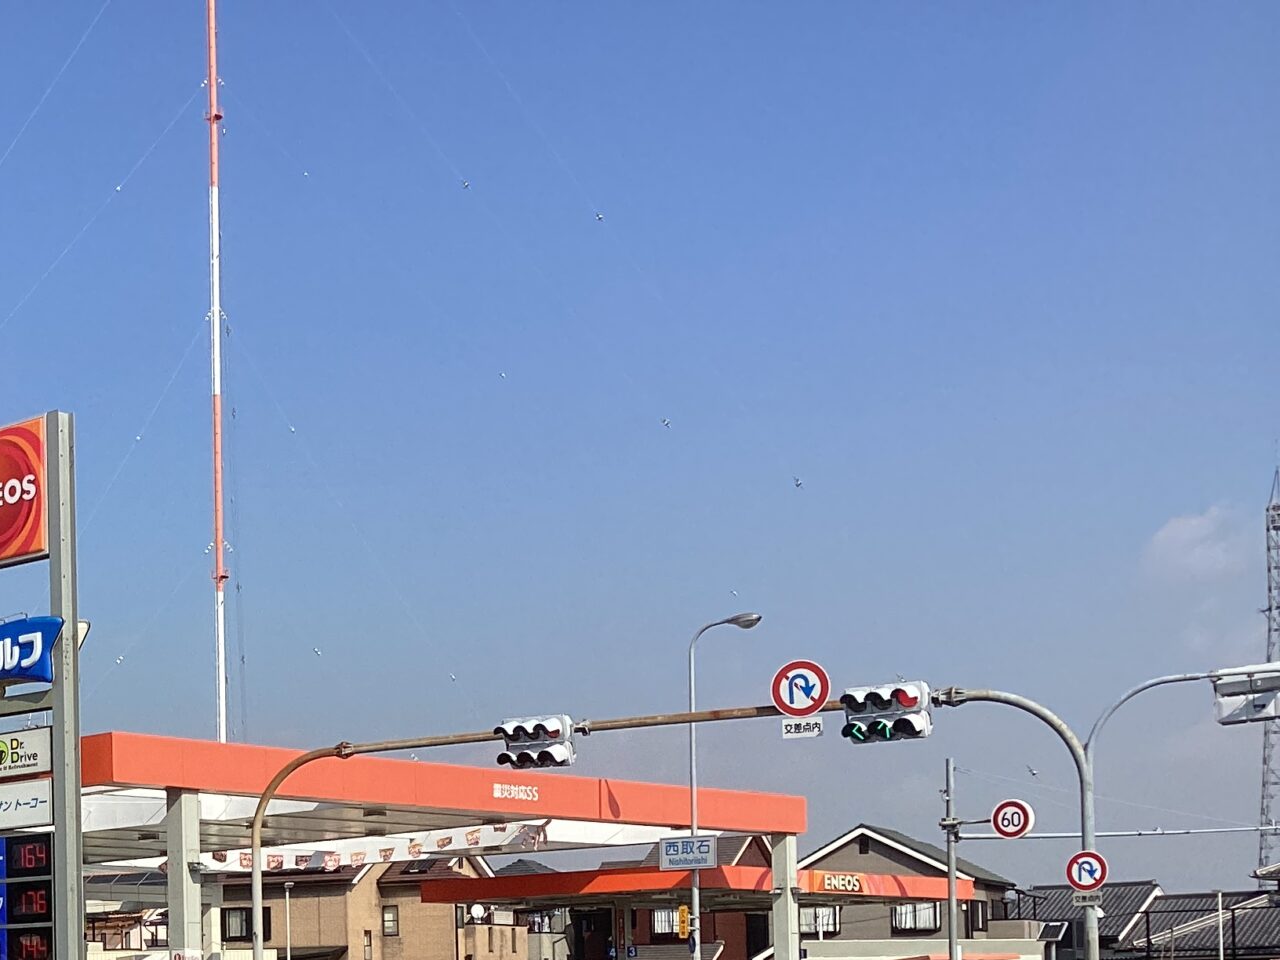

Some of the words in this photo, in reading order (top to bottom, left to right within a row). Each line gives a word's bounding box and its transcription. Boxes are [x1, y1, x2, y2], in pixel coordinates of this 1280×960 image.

[784, 721, 822, 734] 交差点内
[10, 738, 25, 751] Dr.
[11, 751, 38, 764] Drive
[1001, 811, 1021, 828] 60
[665, 840, 711, 856] 西取石
[21, 843, 47, 868] 164
[824, 873, 861, 892] ENEOS
[22, 890, 47, 913] 176
[609, 948, 616, 957] 4
[629, 947, 636, 957] 3
